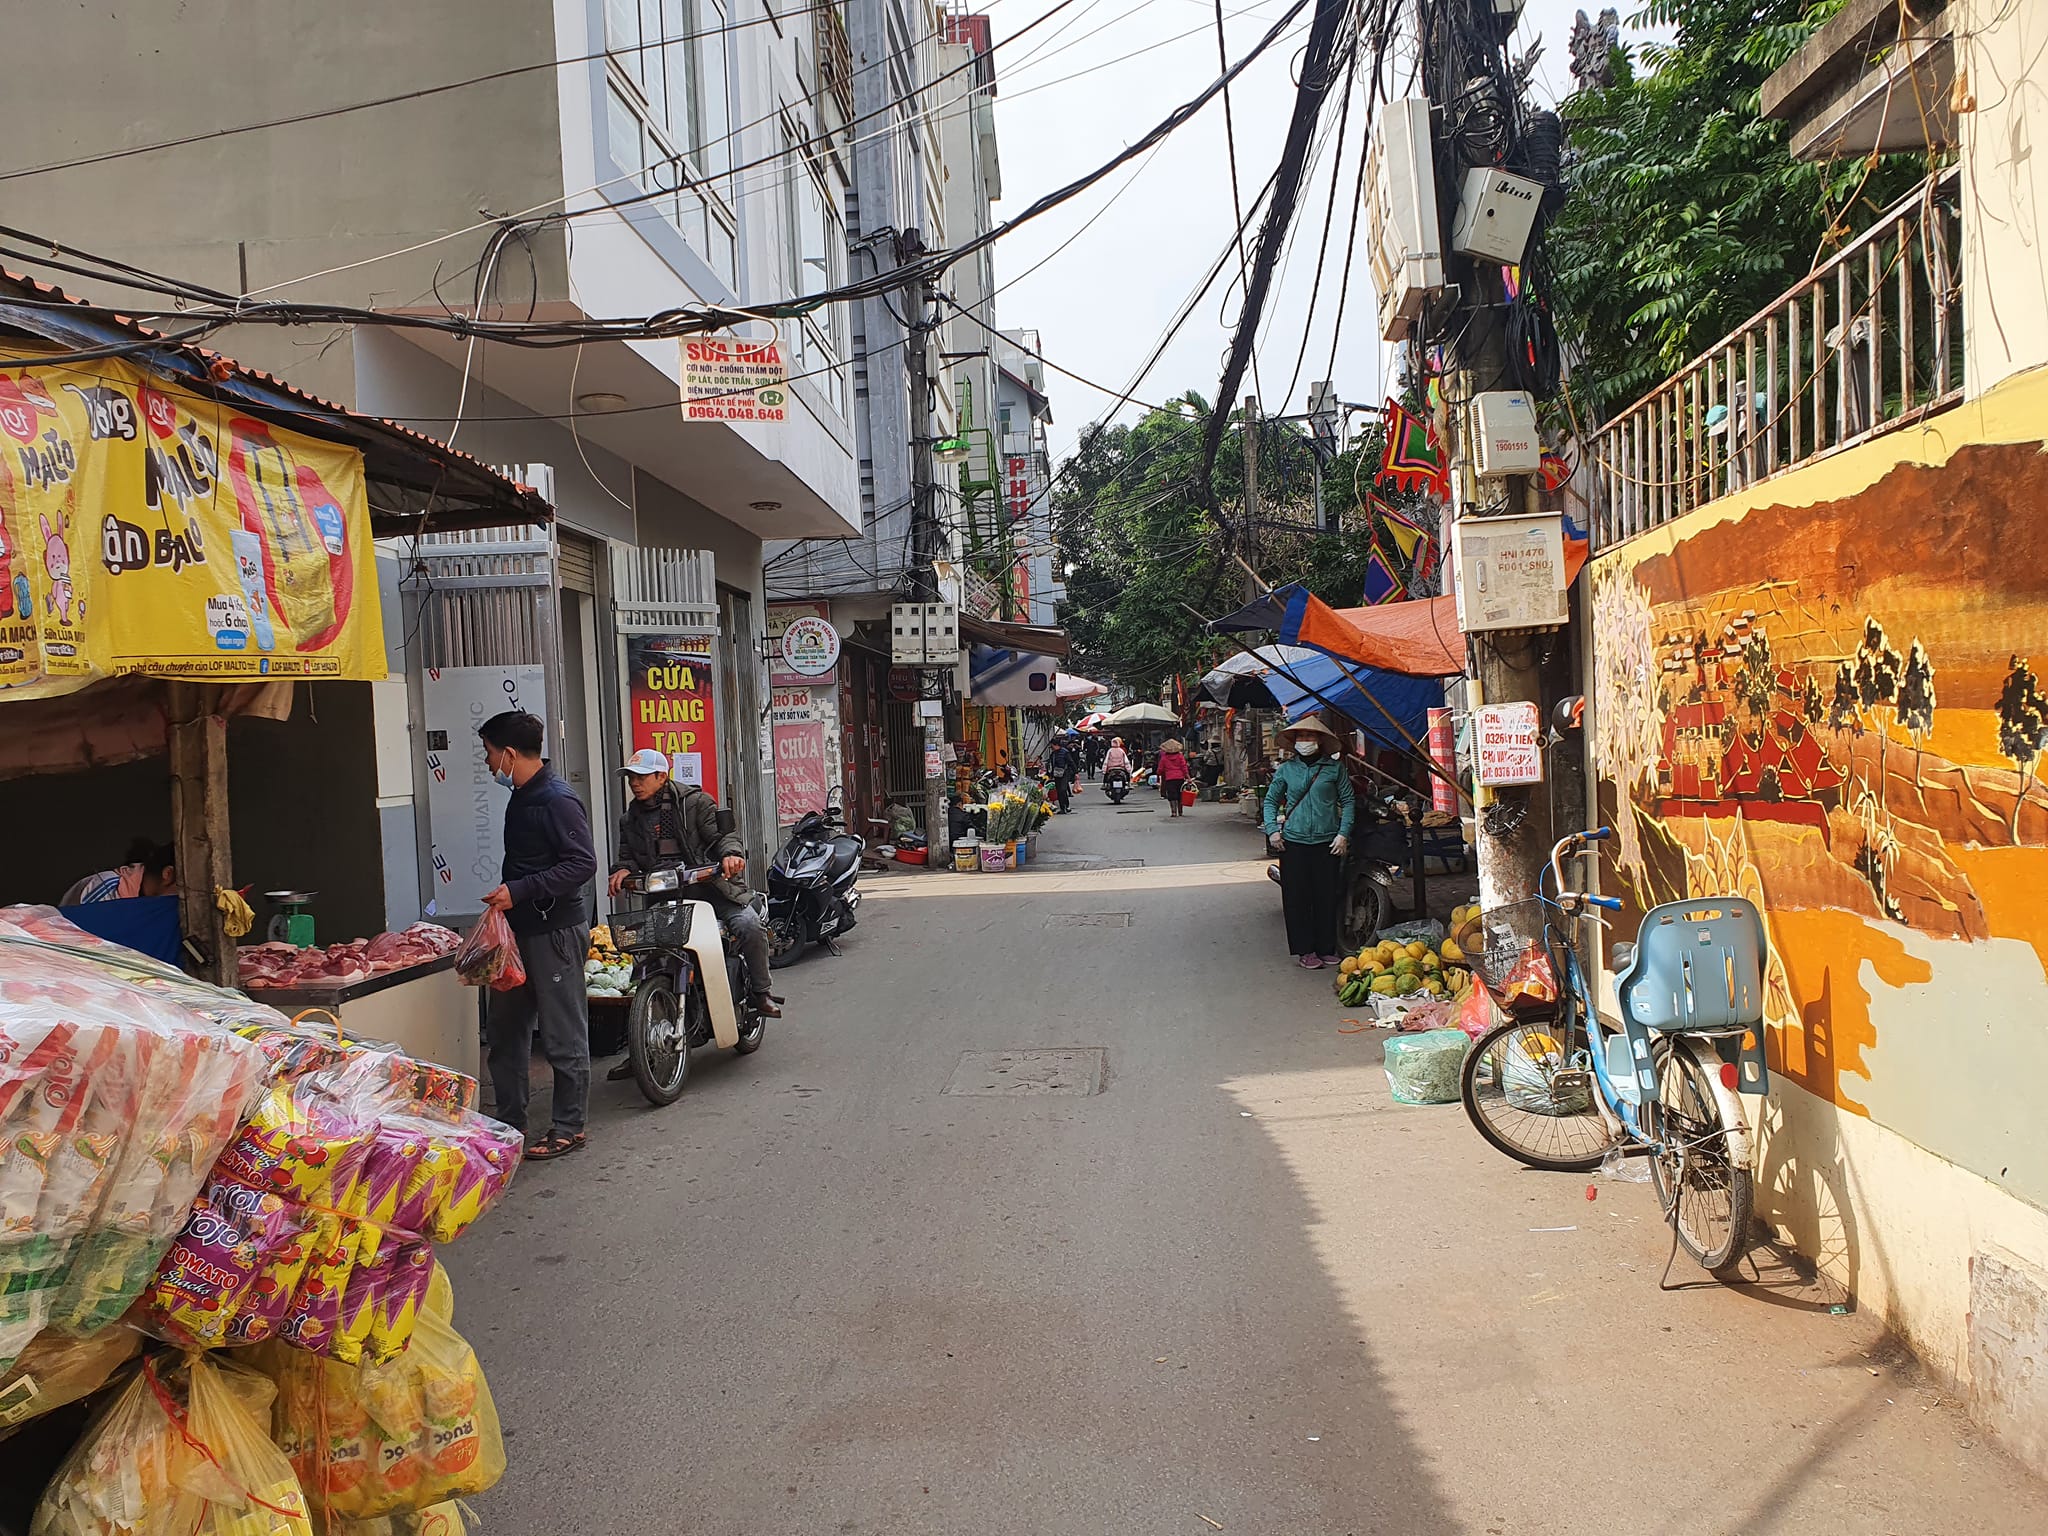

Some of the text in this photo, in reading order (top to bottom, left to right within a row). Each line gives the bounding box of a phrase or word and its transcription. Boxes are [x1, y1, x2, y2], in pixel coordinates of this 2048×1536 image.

[688, 406, 784, 421] 0964.048.648
[17, 427, 77, 494] MALTO
[1495, 441, 1529, 452] 19001515
[144, 416, 222, 516] MALTO
[154, 517, 207, 575] BALO
[207, 597, 228, 610] Mua
[225, 612, 232, 627] 6
[647, 659, 695, 691] CỬA
[640, 694, 705, 724] HÀNG
[779, 731, 820, 761] CHỮA
[179, 1211, 243, 1251] JOJO
[167, 1240, 240, 1290] TOMATO
[160, 1270, 213, 1295] Snacks
